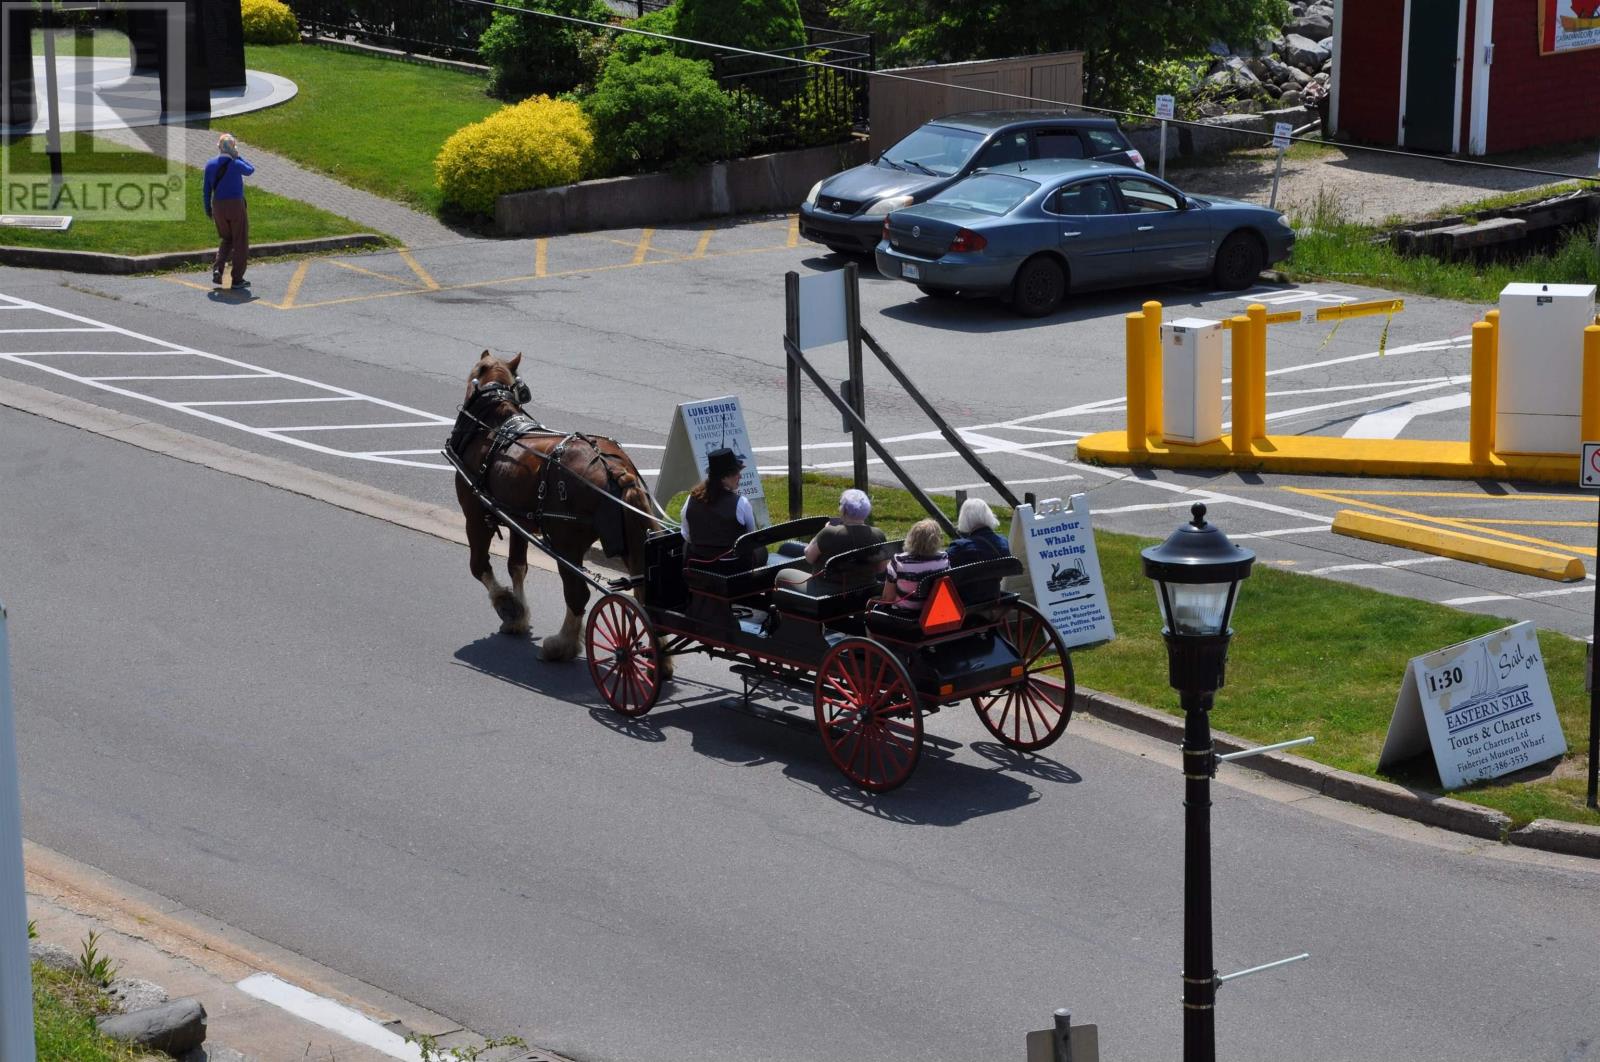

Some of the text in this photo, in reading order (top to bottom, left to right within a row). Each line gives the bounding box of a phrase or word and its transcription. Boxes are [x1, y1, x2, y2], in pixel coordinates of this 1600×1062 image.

[687, 402, 736, 416] LUNENBURG
[694, 412, 736, 425] HERITAGE
[1039, 544, 1086, 560] Watching
[1044, 534, 1076, 546] Whale
[1072, 608, 1102, 619] Waterfront
[1498, 643, 1539, 680] Sail on
[1429, 667, 1463, 692] 1:30
[1446, 690, 1533, 730] EASTERN STAR
[1448, 712, 1542, 750] Tours & Charters
[1457, 734, 1546, 773] Fisheries Museum Wharf
[1467, 729, 1529, 758] Star Charters Ltd
[1479, 753, 1529, 777] 877-386-3535
